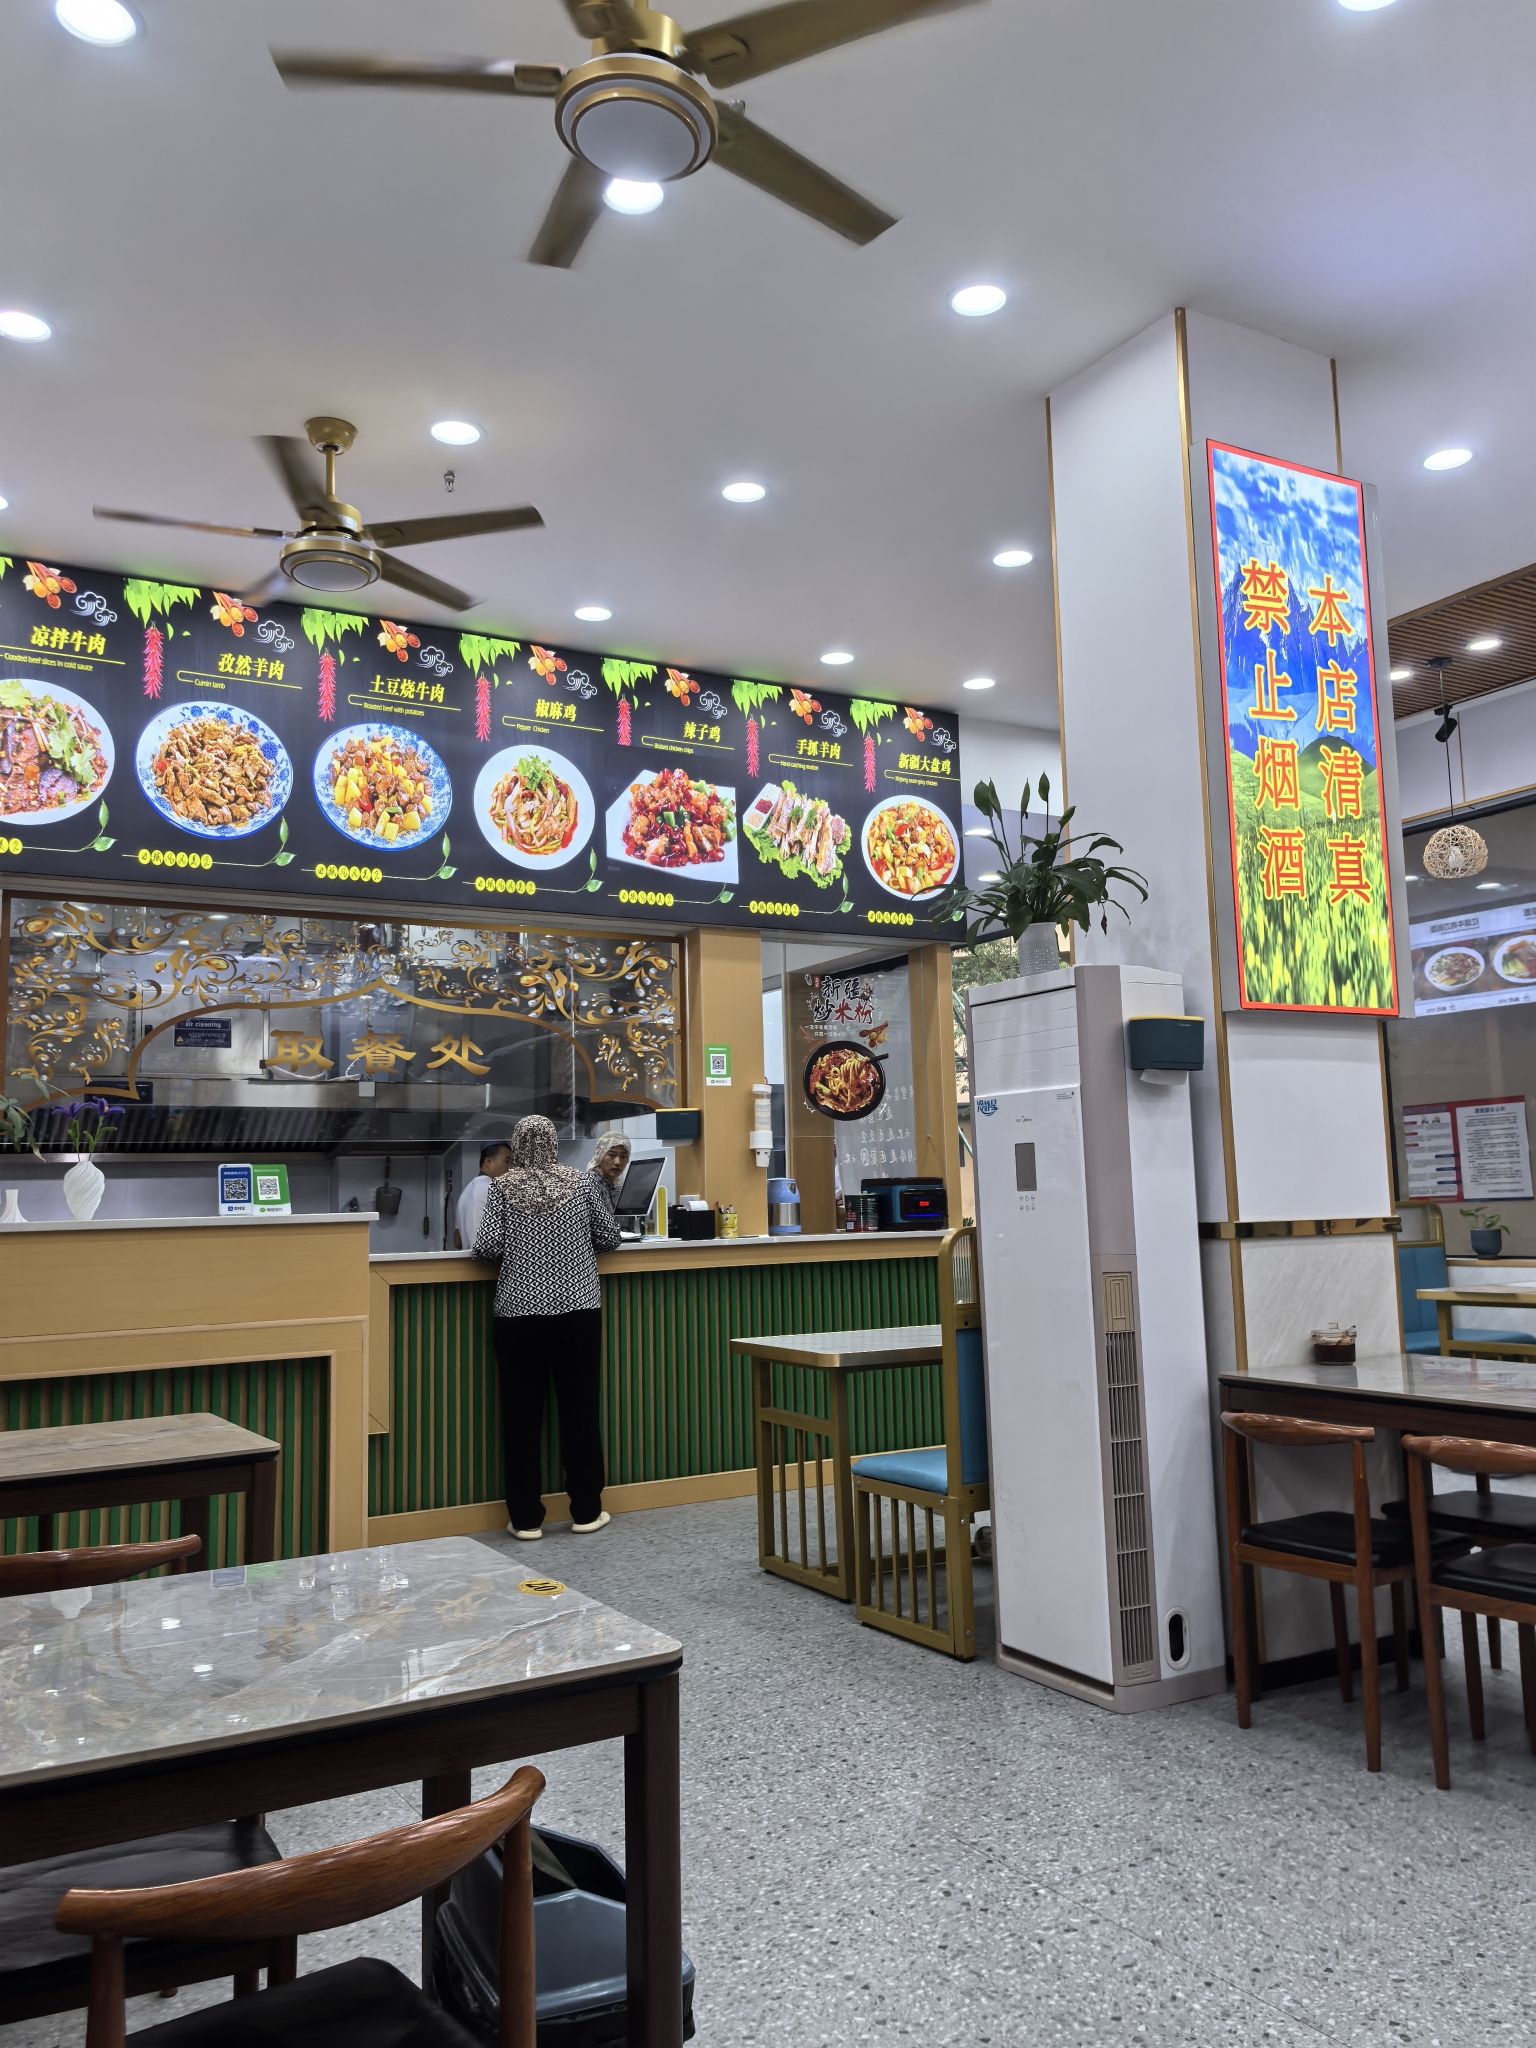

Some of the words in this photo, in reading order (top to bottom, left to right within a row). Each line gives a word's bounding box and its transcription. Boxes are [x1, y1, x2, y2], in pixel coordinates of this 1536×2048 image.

[30, 624, 107, 656] 凉拌牛肉
[64, 661, 76, 669] cold
[218, 652, 285, 681] 孜然羊肉
[194, 678, 212, 688] Cumin
[212, 681, 226, 690] lamb
[368, 674, 445, 703] 土豆烧牛肉
[535, 698, 577, 723] 椒麻鸡
[683, 721, 721, 743] 辣子鸡
[1240, 559, 1307, 902] 禁止烟酒
[1308, 574, 1373, 907] 本店清真
[796, 738, 841, 760] 手抓羊肉
[898, 751, 951, 775] 新疆大盘鸡
[821, 975, 861, 1001] 新疆
[813, 998, 875, 1025] 炒米粉
[265, 1029, 491, 1077] 取餐处
